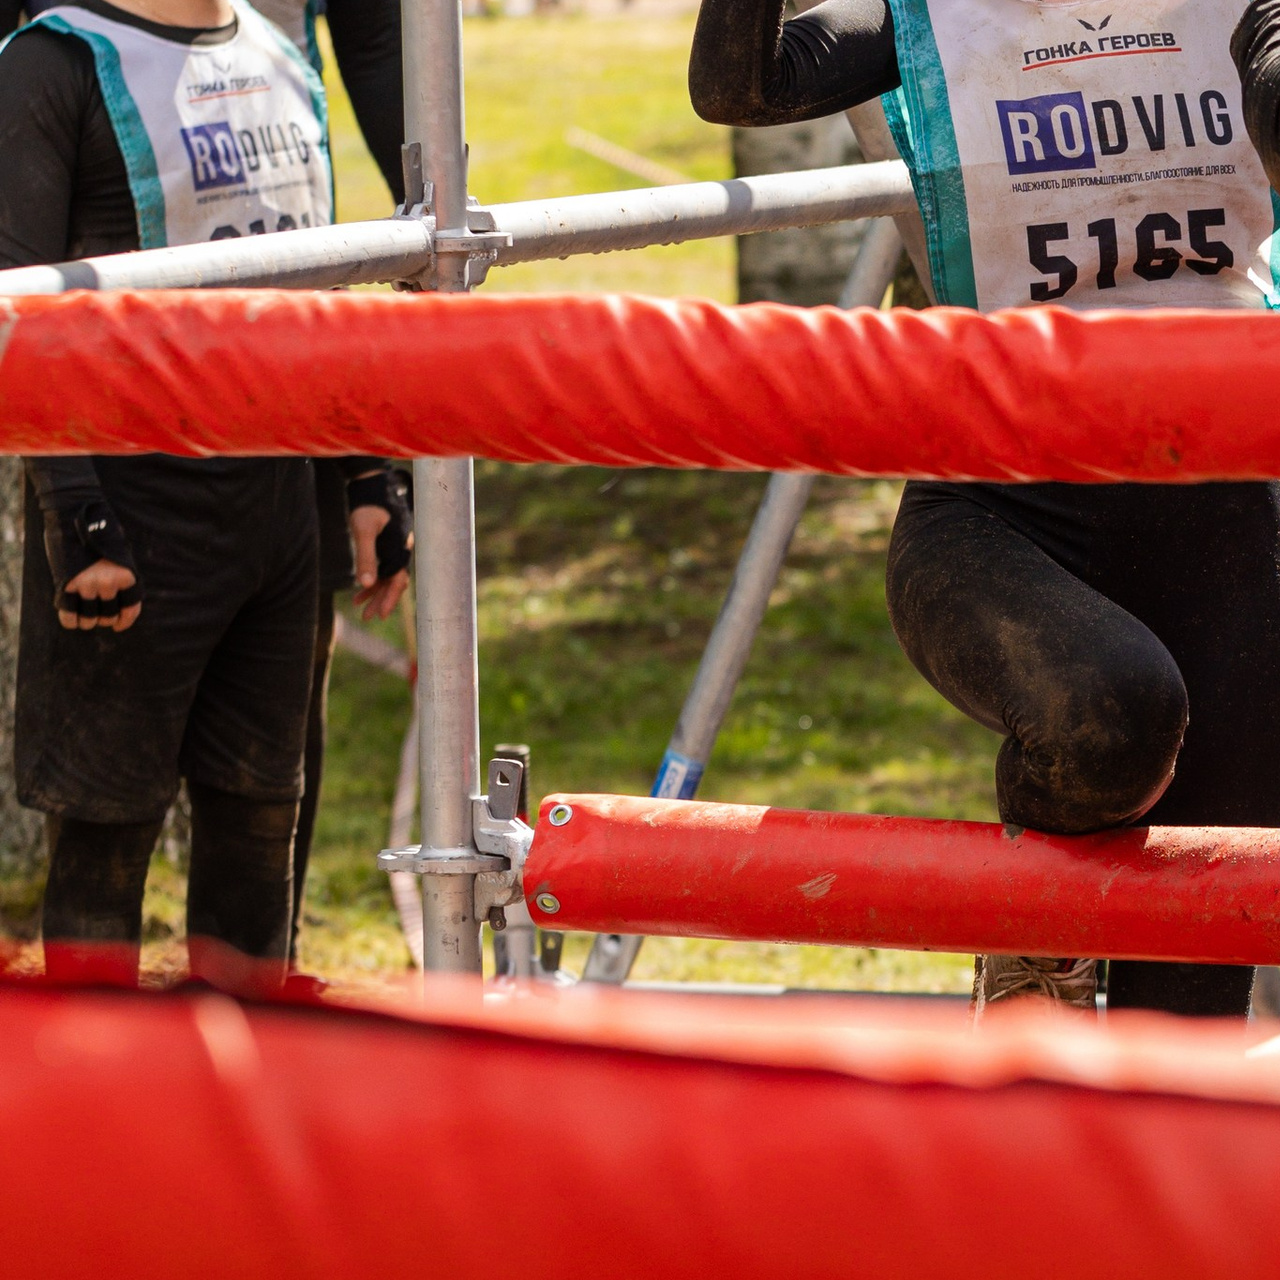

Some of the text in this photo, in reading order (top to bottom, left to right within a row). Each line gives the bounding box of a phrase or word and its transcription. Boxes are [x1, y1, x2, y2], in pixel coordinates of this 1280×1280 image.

[1023, 32, 1176, 65] ГОНКА ГЕРОЕВ
[189, 122, 310, 183] RODVIG
[1007, 89, 1234, 163] RODVIG
[1011, 179, 1061, 193] НАДЕЖНОСТЬ
[1061, 177, 1077, 189] ДЛЯ
[1145, 166, 1204, 181] БЛАГОСОСТОЯНИЕ
[1205, 165, 1220, 177] ДЛЯ
[1220, 164, 1237, 175] ВСЕХ
[1026, 208, 1235, 302] 5165
